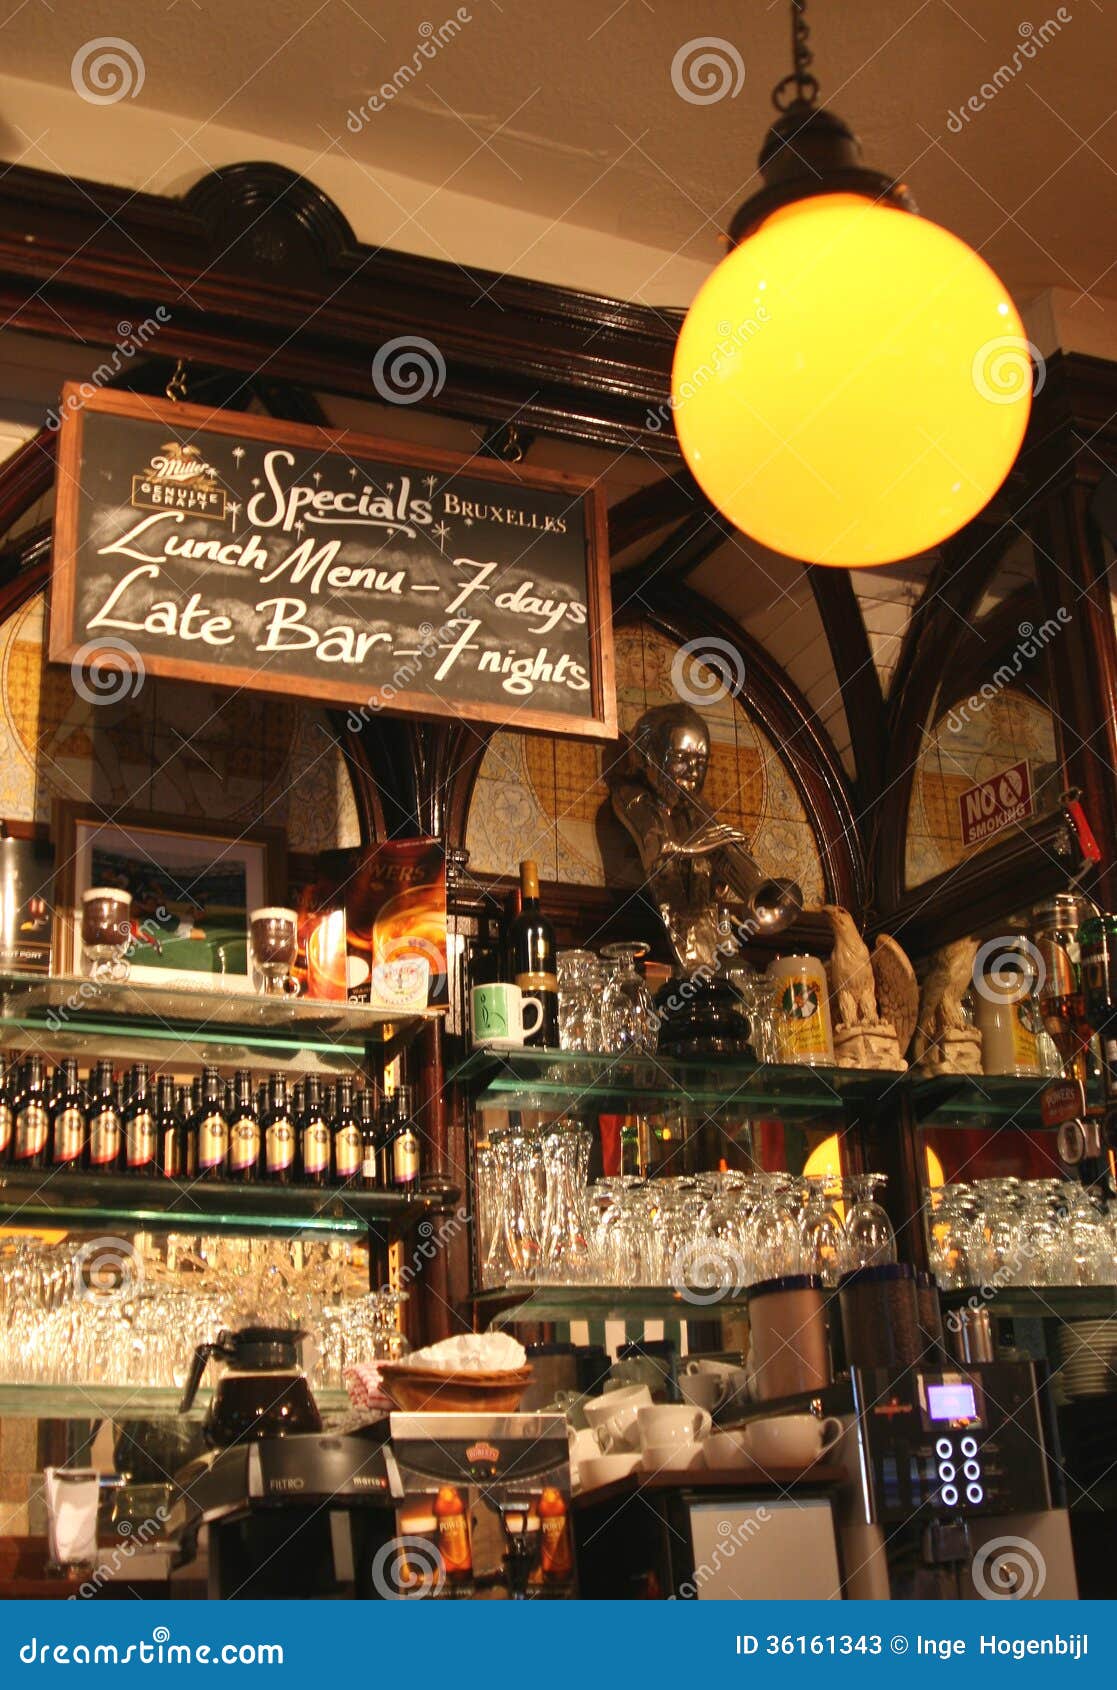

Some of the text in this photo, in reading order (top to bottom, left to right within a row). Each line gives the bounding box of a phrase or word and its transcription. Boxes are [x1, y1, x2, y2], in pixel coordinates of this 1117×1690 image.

[151, 456, 209, 480] Miller
[141, 483, 218, 504] GENUINE
[152, 494, 207, 510] DRAFT
[247, 450, 567, 533] Specials BRUXELLES
[97, 511, 268, 570] Lunch
[259, 538, 405, 594] Menu
[445, 558, 498, 614] 7
[495, 581, 587, 634] days
[86, 564, 235, 645] Late
[256, 597, 392, 663] Bar
[434, 618, 482, 681] 7
[478, 648, 590, 695] nights
[966, 784, 996, 825] NO
[968, 802, 1025, 841] SMOKING
[270, 1478, 304, 1490] FILTRO
